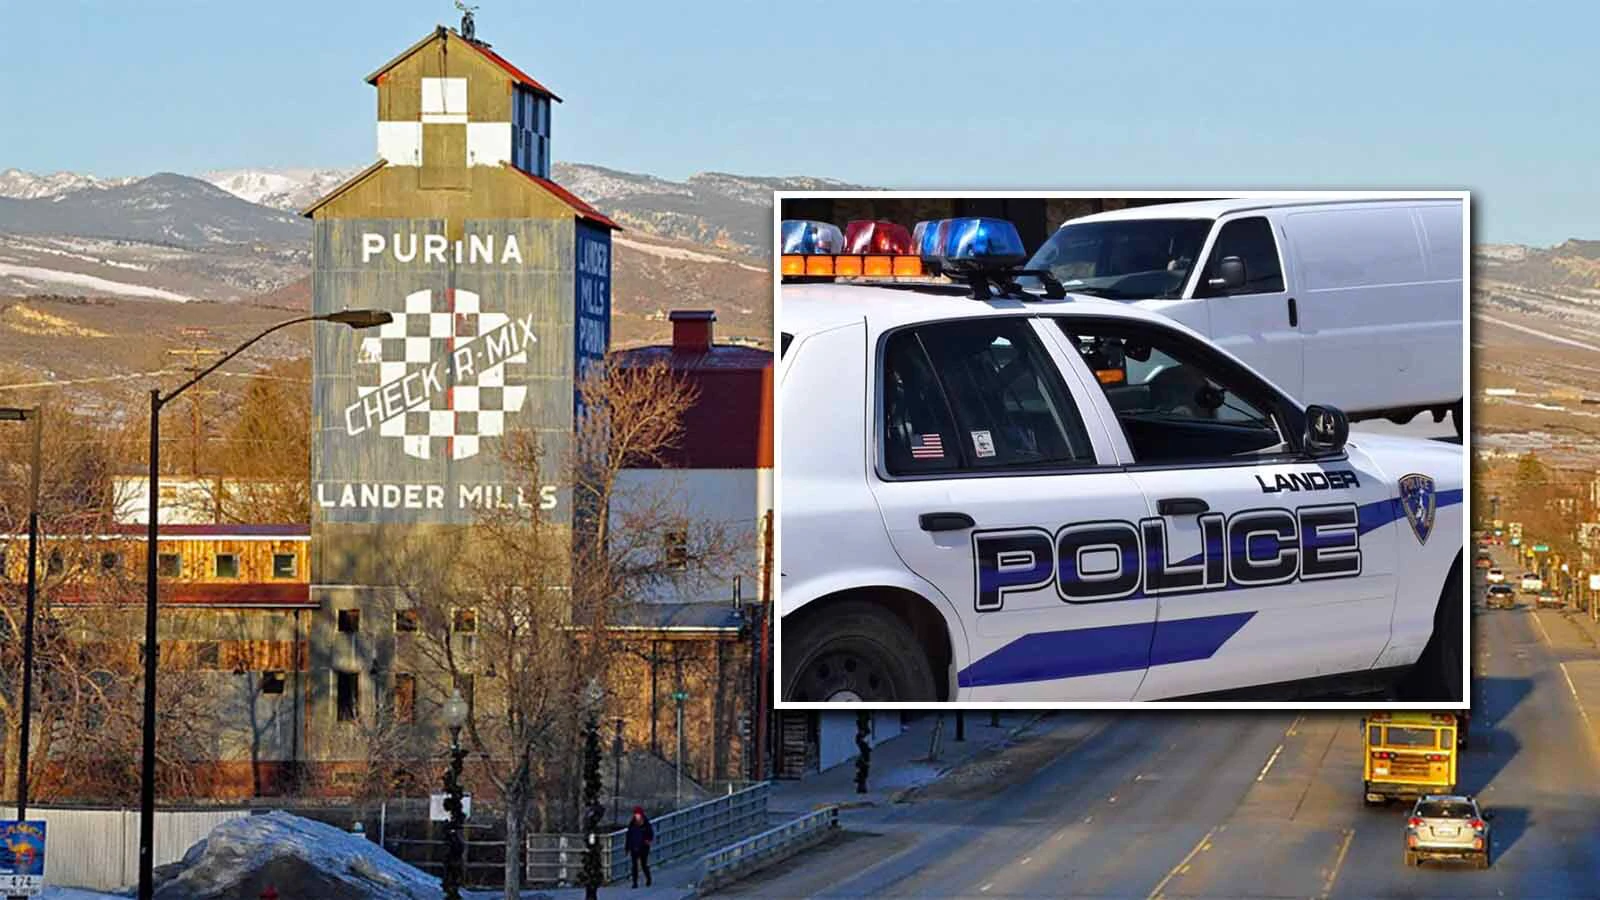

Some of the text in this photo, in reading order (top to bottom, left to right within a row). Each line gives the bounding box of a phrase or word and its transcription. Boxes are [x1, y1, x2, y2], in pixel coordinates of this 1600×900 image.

[362, 233, 523, 265] PURINA
[1256, 469, 1361, 494] LANDER
[316, 483, 558, 510] LANDER MILLS
[972, 502, 1363, 613] POLICE
